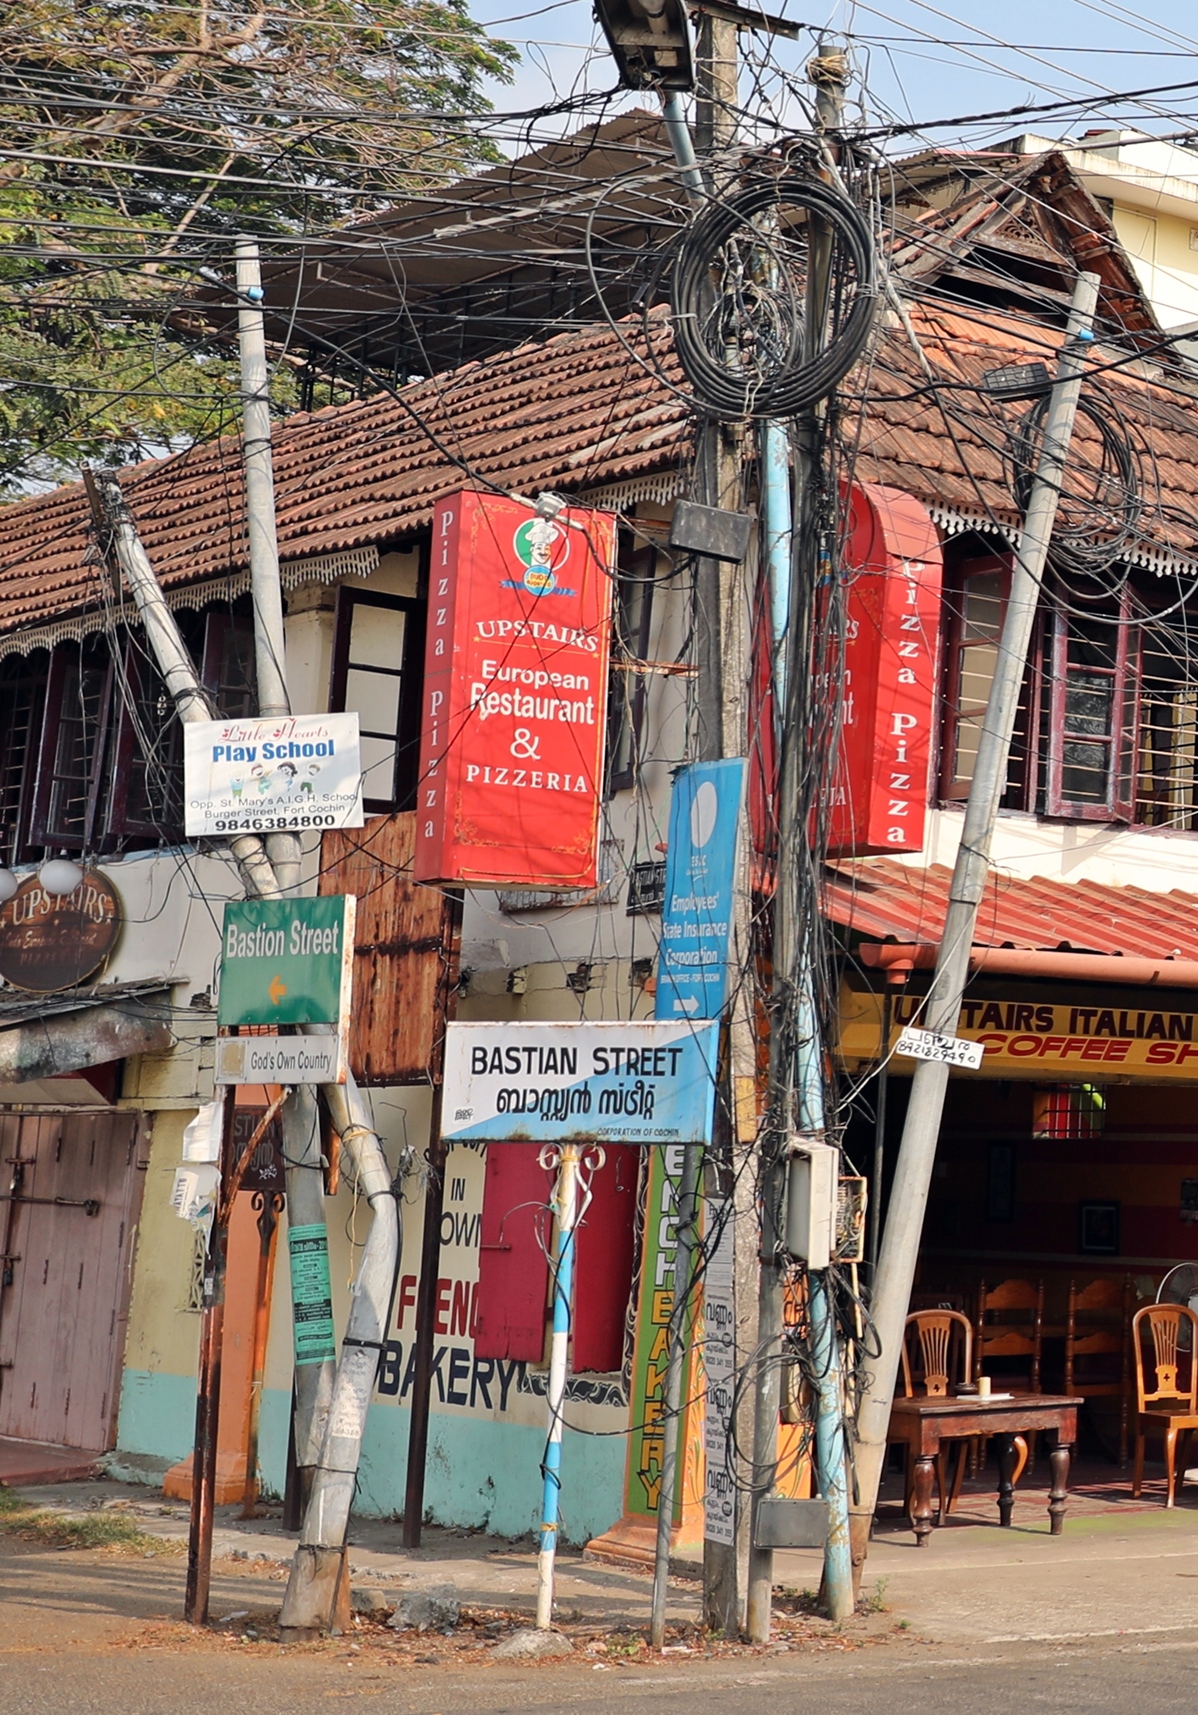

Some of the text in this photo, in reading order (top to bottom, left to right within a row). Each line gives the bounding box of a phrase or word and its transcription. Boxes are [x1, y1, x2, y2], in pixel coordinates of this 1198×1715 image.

[476, 619, 599, 652] UPSTAIRS
[424, 511, 454, 838] Pizza Pizza
[481, 659, 589, 691] European
[470, 682, 594, 725] Restaurant
[218, 719, 329, 743] Little Hearts
[509, 728, 541, 760] &
[212, 739, 335, 763] Play School
[466, 764, 588, 793] PIZZERIA
[886, 712, 917, 843] Pizza
[190, 800, 217, 811] Opp.
[220, 799, 235, 808] St.
[238, 796, 273, 808] Mary's
[323, 793, 357, 802] Schoo
[204, 804, 345, 820] Burger Street, Fort Cochin
[215, 815, 336, 832] 9846384800
[226, 919, 339, 959] Bastion Street
[663, 920, 728, 939] State Insurance
[666, 946, 718, 970] Corporation
[894, 997, 1054, 1033] UTAIRS
[1069, 1007, 1194, 1041] ITALIAN
[251, 1050, 332, 1073] God's Own Country
[471, 1046, 683, 1077] BASTIAN STREET
[975, 1033, 1134, 1062] COFFEE
[597, 1127, 642, 1136] CORPORATION
[643, 1127, 653, 1136] OF
